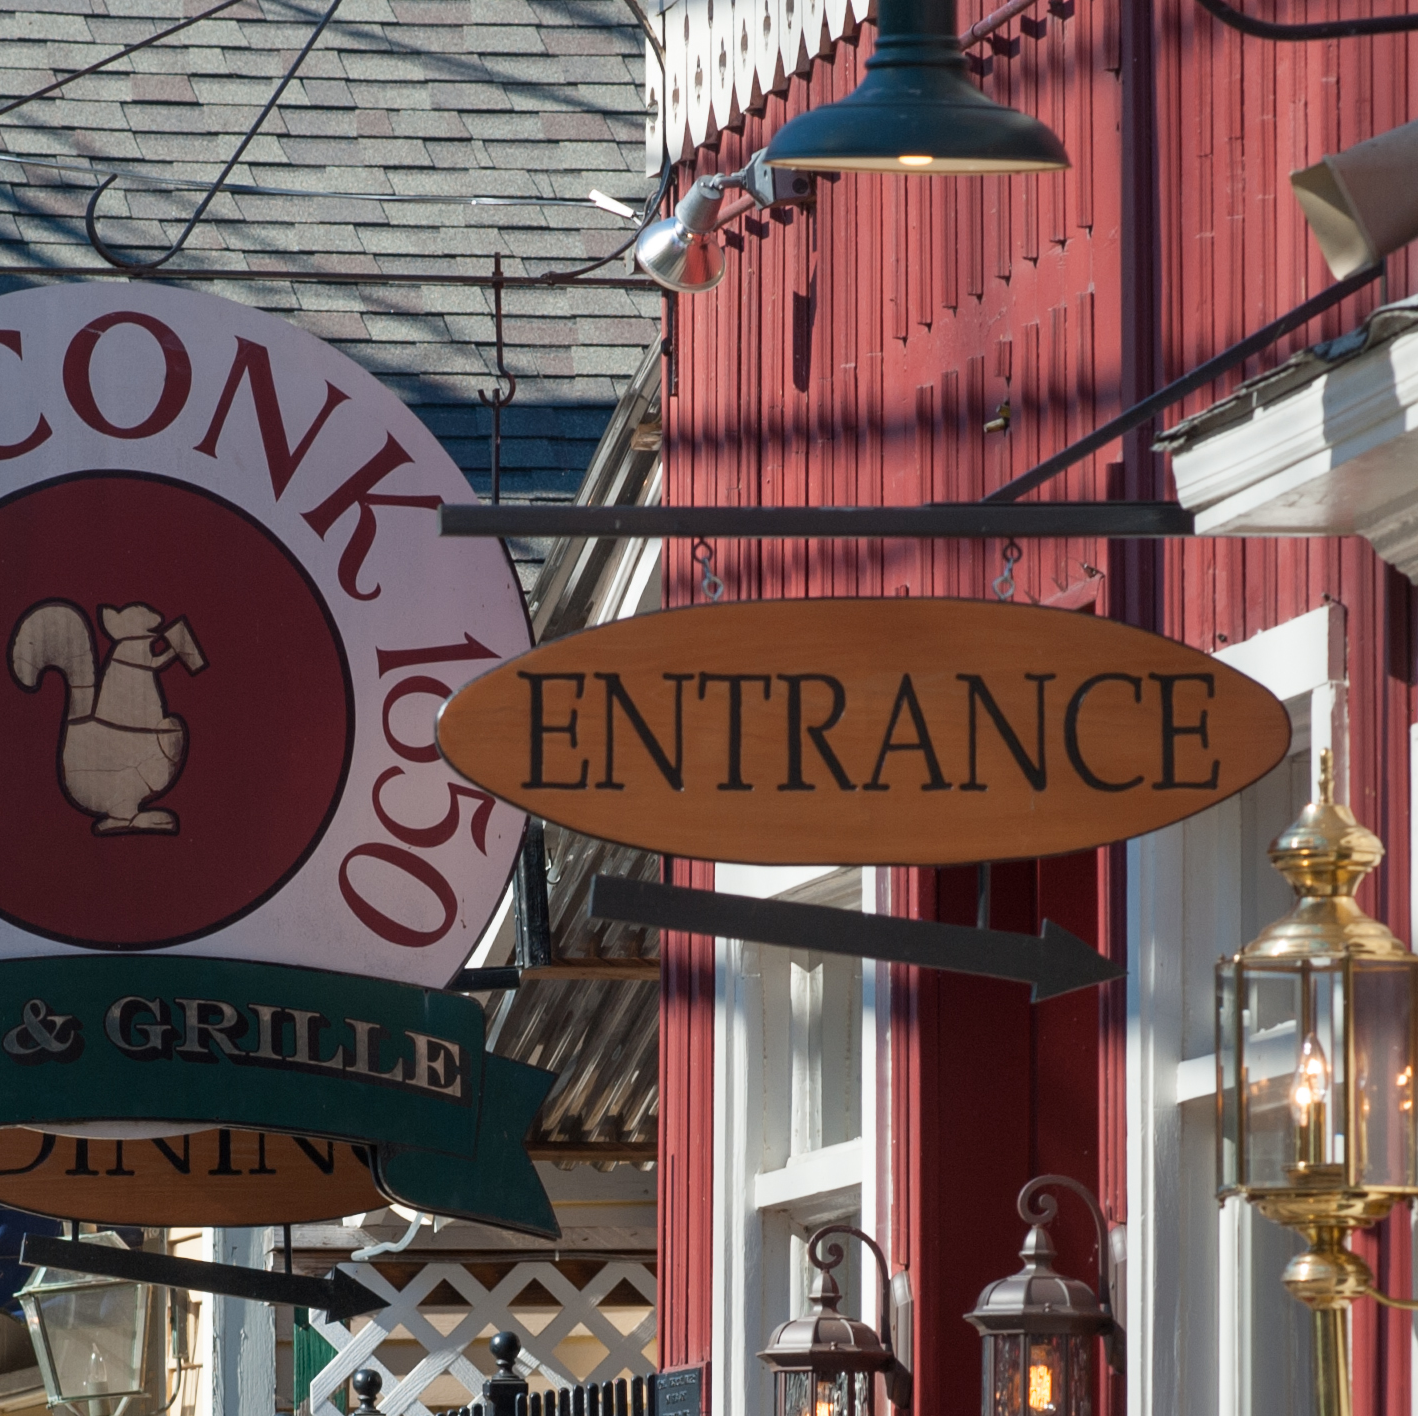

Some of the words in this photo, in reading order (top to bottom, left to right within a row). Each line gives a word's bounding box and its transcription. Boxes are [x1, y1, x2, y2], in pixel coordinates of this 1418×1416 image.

[518, 671, 1221, 792] ENTRANCE
[1, 998, 77, 1056] &
[103, 995, 463, 1099] GRILLE
